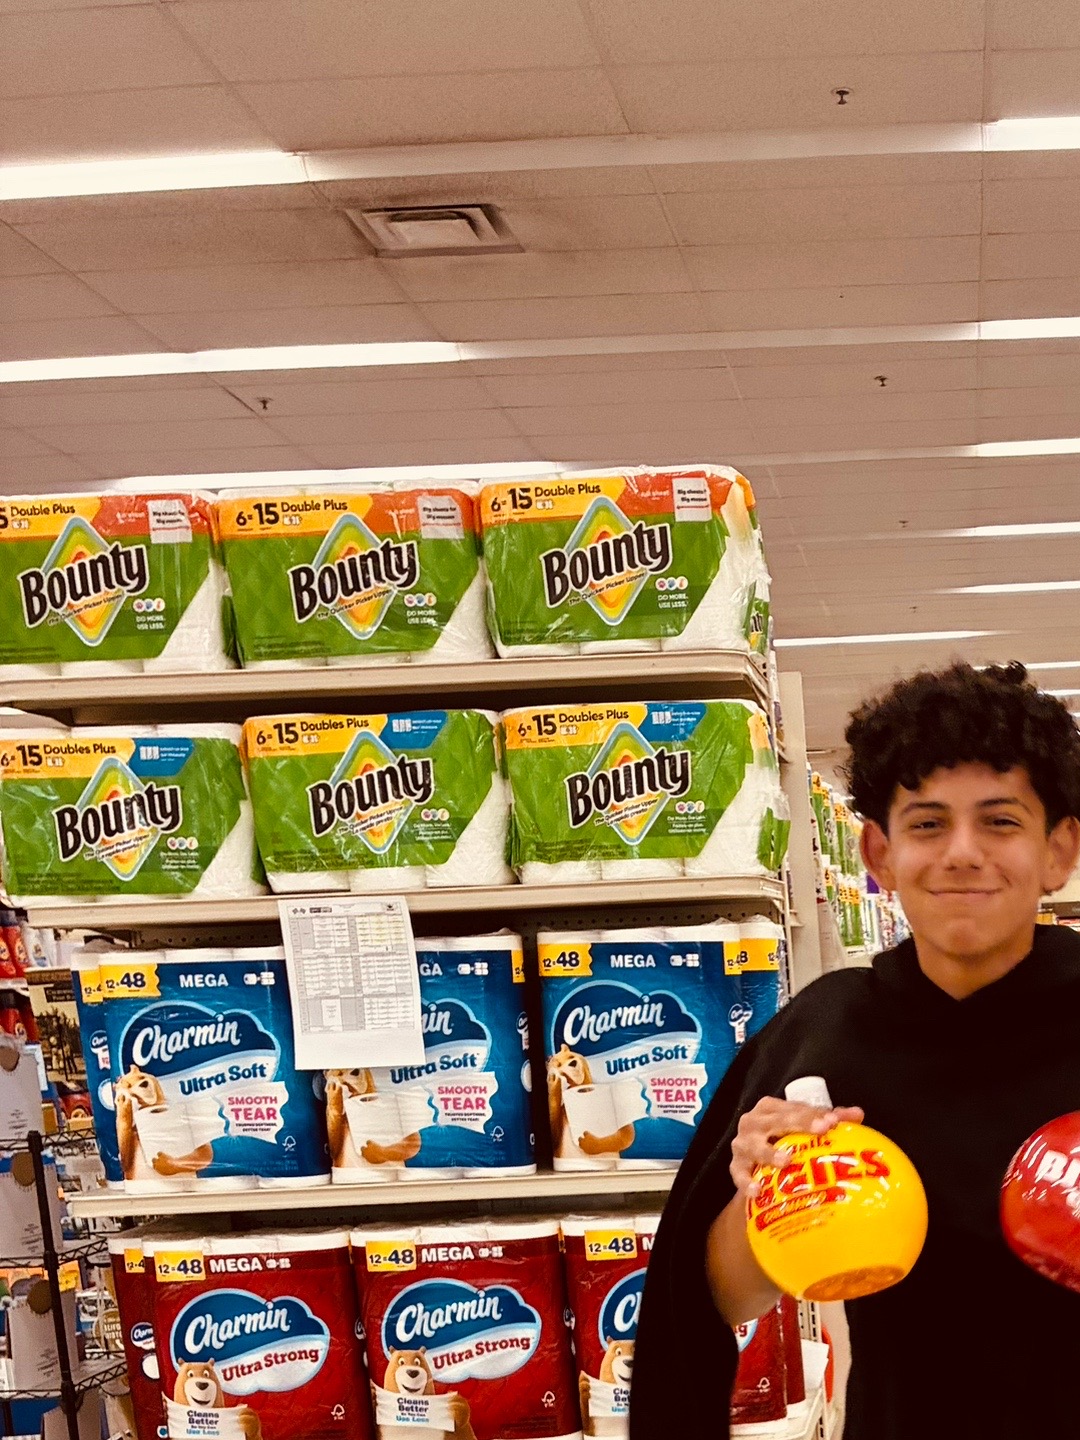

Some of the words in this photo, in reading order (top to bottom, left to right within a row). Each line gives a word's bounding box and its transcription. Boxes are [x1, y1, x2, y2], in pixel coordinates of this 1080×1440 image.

[534, 486, 574, 497] Double
[577, 484, 601, 495] Plus
[11, 504, 50, 516] Double
[52, 503, 75, 514] Plus
[281, 501, 321, 514] Double
[324, 499, 348, 511] Plus
[541, 521, 671, 607] Bounty
[19, 543, 148, 627] Bounty
[288, 539, 419, 622] Bounty
[559, 711, 603, 723] Doubles
[605, 709, 629, 721] Plus
[300, 719, 344, 732] Doubles
[347, 717, 369, 729] Plus
[43, 744, 90, 756] Doubles
[93, 742, 116, 753] Plus
[308, 754, 433, 836] Bounty
[565, 747, 691, 828] Bounty
[54, 783, 182, 861] Bounty
[610, 953, 656, 968] MEGA
[179, 973, 229, 988] MEGA
[563, 994, 664, 1045] Charmin
[132, 1013, 241, 1065] Charmin
[605, 1056, 650, 1076] Ultra
[653, 1045, 689, 1063] Soft
[390, 1062, 436, 1085] Ultra
[439, 1052, 478, 1069] Soft
[179, 1072, 226, 1096] Ultra
[228, 1063, 267, 1081] Soft
[650, 1077, 698, 1087] SMOOTH
[437, 1085, 488, 1096] SMOOTH
[652, 1089, 697, 1102] TEAR
[228, 1095, 278, 1106] SMOOTH
[440, 1097, 487, 1110] TEAR
[231, 1107, 278, 1121] TEAR
[421, 1247, 475, 1262] MEGA
[209, 1258, 263, 1273] MEGA
[396, 1290, 502, 1343] Charmin
[185, 1301, 291, 1354] Charmin
[433, 1349, 474, 1371] Ultra
[475, 1335, 531, 1357] Strong
[221, 1362, 263, 1382] Ultra
[264, 1347, 319, 1370] Strong
[396, 1397, 430, 1406] Cleans
[399, 1405, 428, 1413] Better
[187, 1410, 220, 1419] Cleans
[188, 1418, 219, 1426] Better
